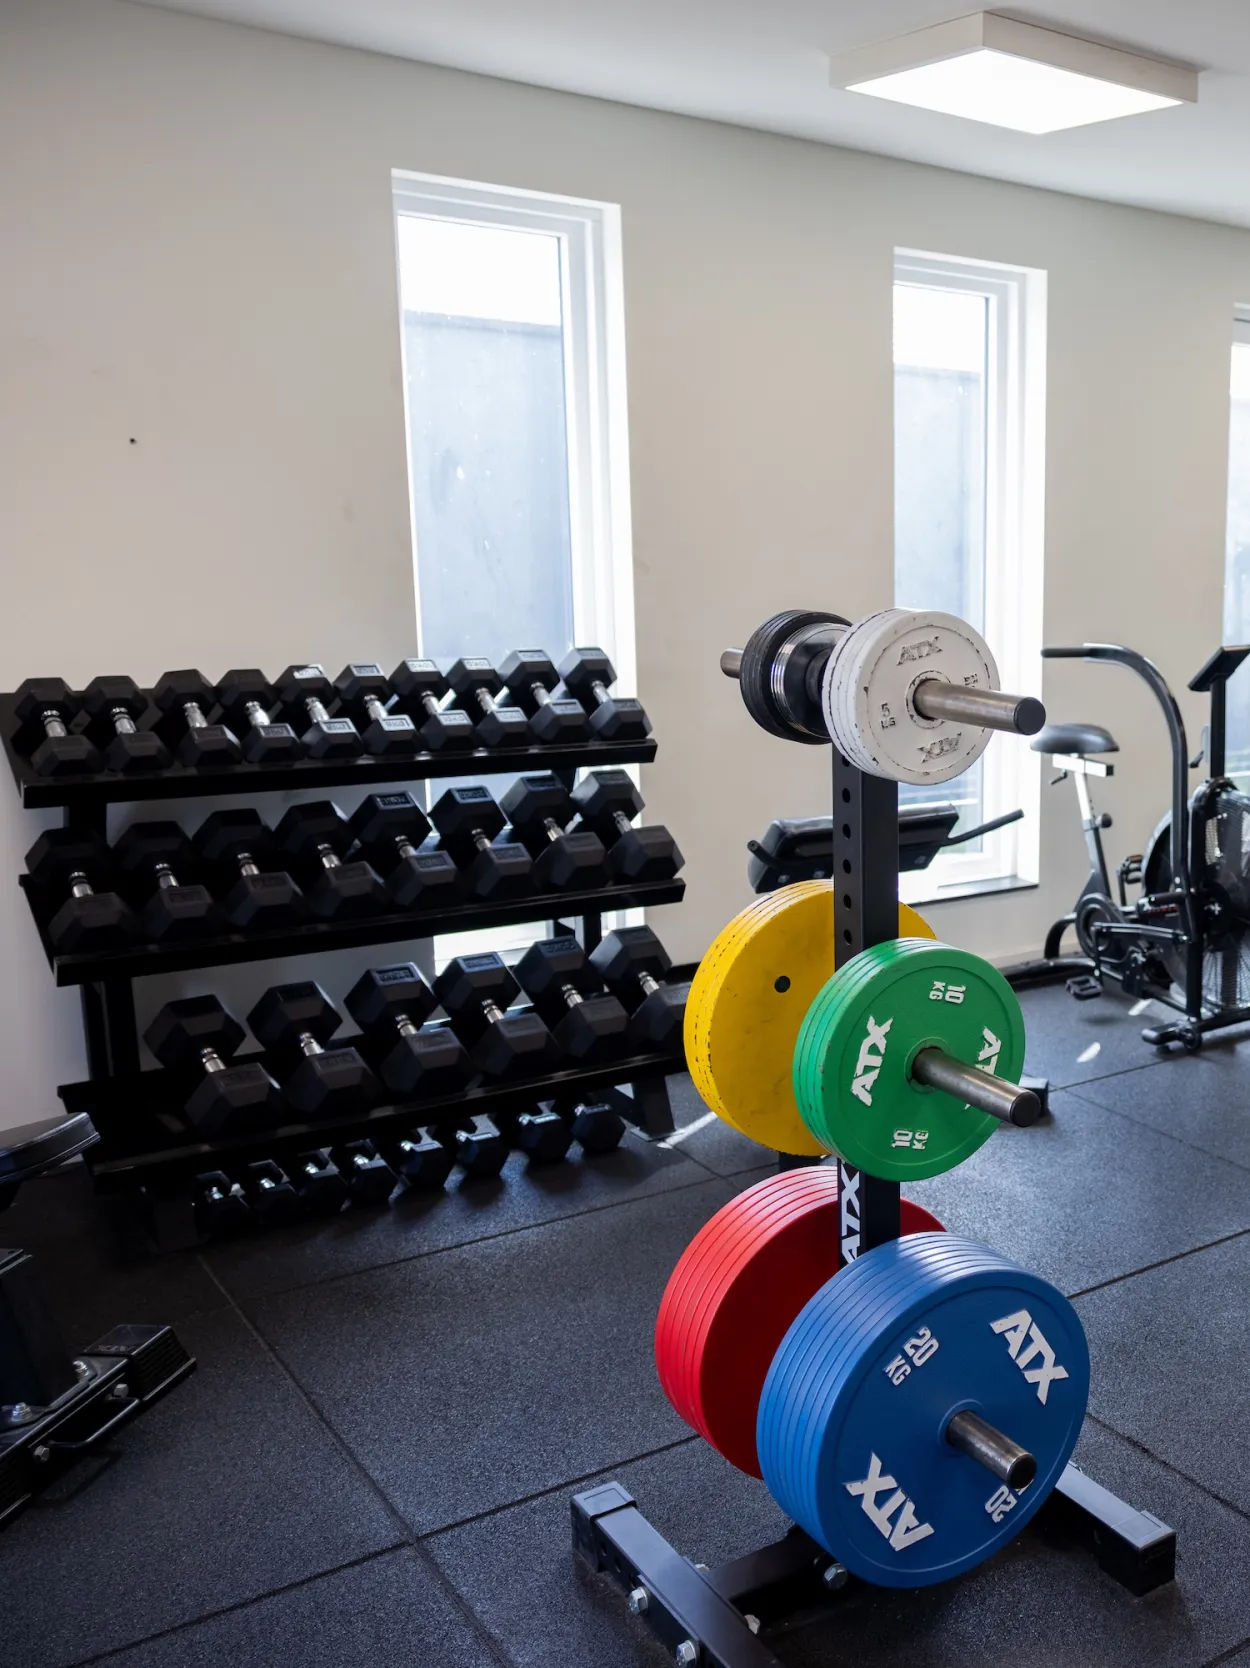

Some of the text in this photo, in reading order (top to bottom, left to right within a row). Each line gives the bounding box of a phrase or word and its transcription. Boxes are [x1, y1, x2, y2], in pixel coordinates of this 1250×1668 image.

[896, 636, 943, 666] ATX
[880, 702, 890, 718] 5
[917, 732, 962, 764] ATX
[929, 980, 946, 1001] KG
[945, 984, 967, 1005] 10
[850, 1015, 894, 1107] ATX
[891, 1129, 913, 1149] 10
[912, 1129, 929, 1150] KG
[903, 1326, 940, 1368] 20
[989, 1308, 1069, 1406] ATX
[884, 1355, 911, 1387] KG
[843, 1451, 936, 1553] ATX
[984, 1485, 1018, 1523] 20
